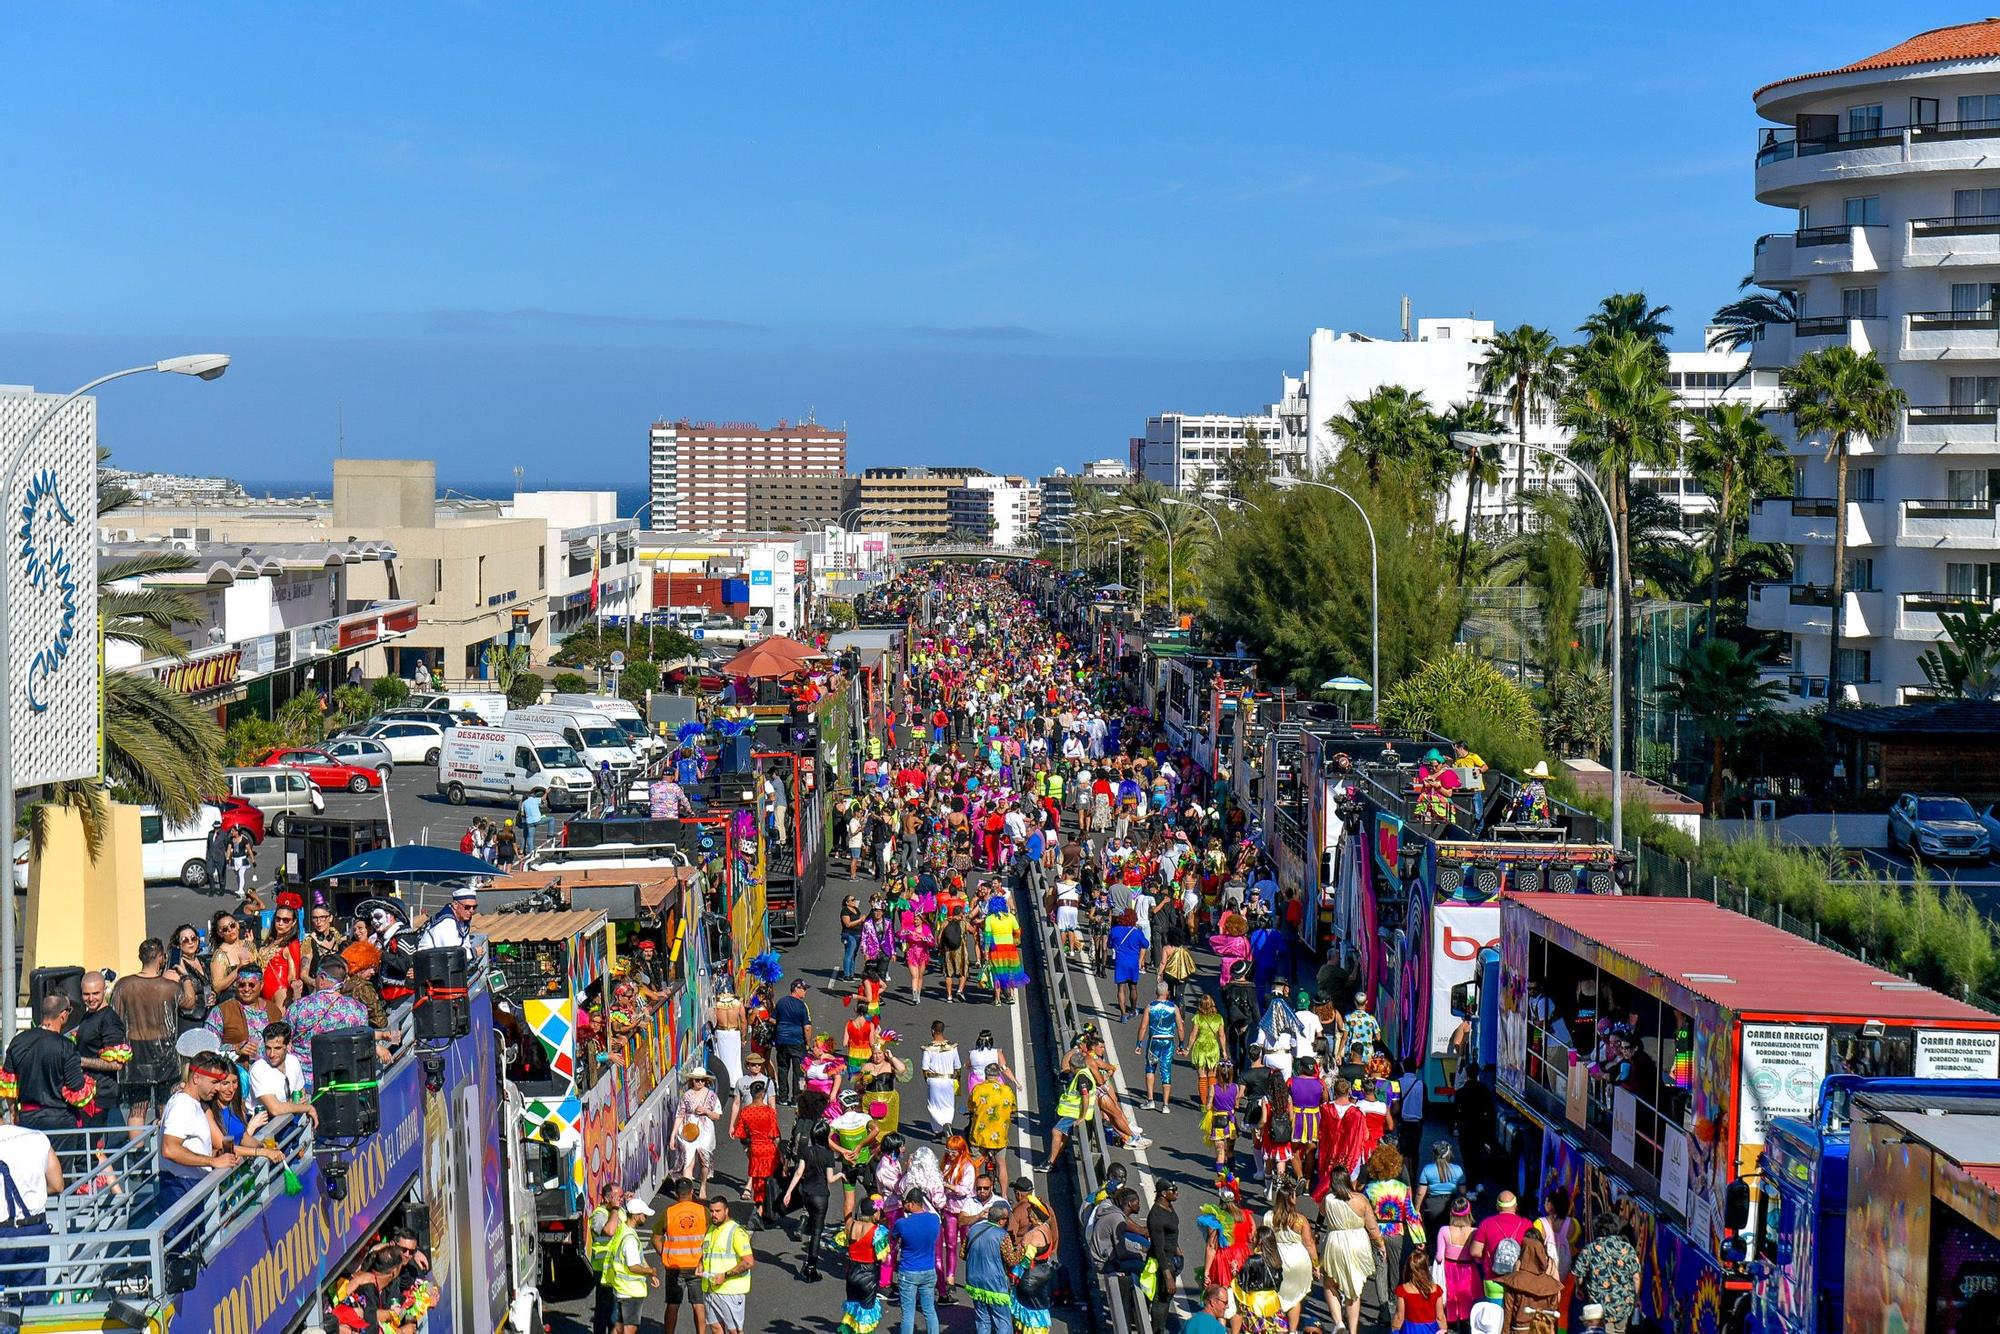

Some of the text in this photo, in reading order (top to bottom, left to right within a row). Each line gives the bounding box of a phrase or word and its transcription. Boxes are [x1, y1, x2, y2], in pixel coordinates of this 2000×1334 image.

[515, 713, 555, 724] DESATASCOS
[457, 730, 506, 742] DESATASCOS
[483, 777, 510, 785] DESATASCOS
[1747, 1030, 1824, 1041] CARMEN ARREGLOS
[1750, 1041, 1801, 1049] PERSONALIZACIÓN
[1920, 1037, 1996, 1047] CARMEN ARREGLOS
[213, 1196, 330, 1334] momentos
[385, 1133, 396, 1172] DEL
